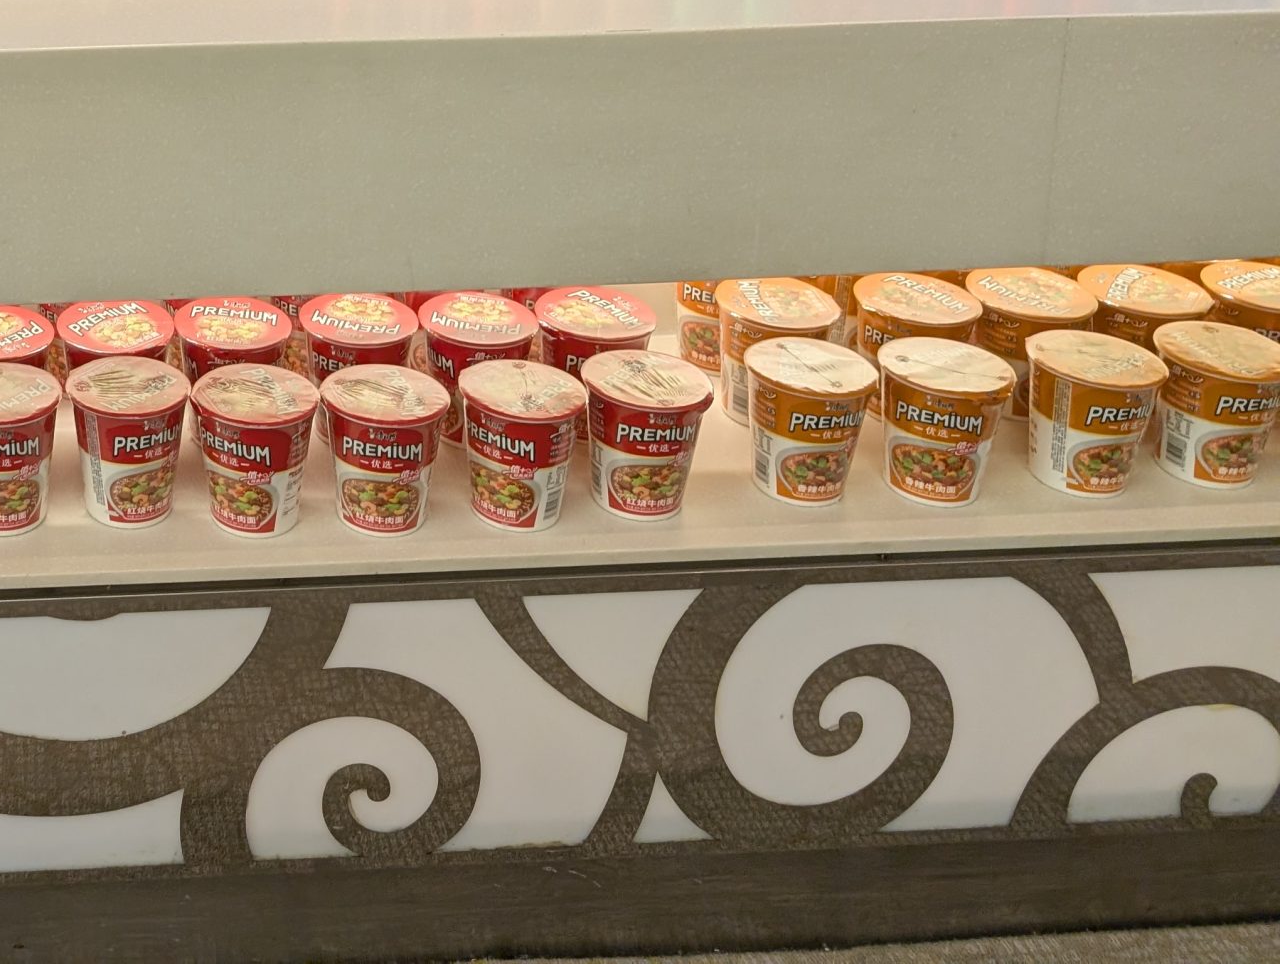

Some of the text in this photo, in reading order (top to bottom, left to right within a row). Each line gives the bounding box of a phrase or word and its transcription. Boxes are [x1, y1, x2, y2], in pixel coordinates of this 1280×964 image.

[883, 275, 969, 313] PREMIUM
[978, 276, 1071, 314] PREMIUM
[67, 302, 148, 336] PREMIUM
[191, 306, 278, 326] PREMIUM
[568, 290, 645, 329] PREMIUM
[312, 310, 400, 335] PREMIUM
[431, 312, 521, 335] PREMIUM
[896, 400, 983, 436] PREMIUM
[467, 420, 534, 462] PREMIUM
[616, 423, 696, 443] PREMIUM
[823, 430, 841, 440] 优选
[926, 427, 949, 438] 优选
[145, 447, 162, 459] 优选
[201, 428, 271, 466] PREMIUM
[343, 436, 423, 462] PREMIUM
[483, 445, 502, 460] 优选
[649, 444, 669, 453] 优选
[220, 454, 239, 467] 优选
[371, 459, 393, 470] 优选
